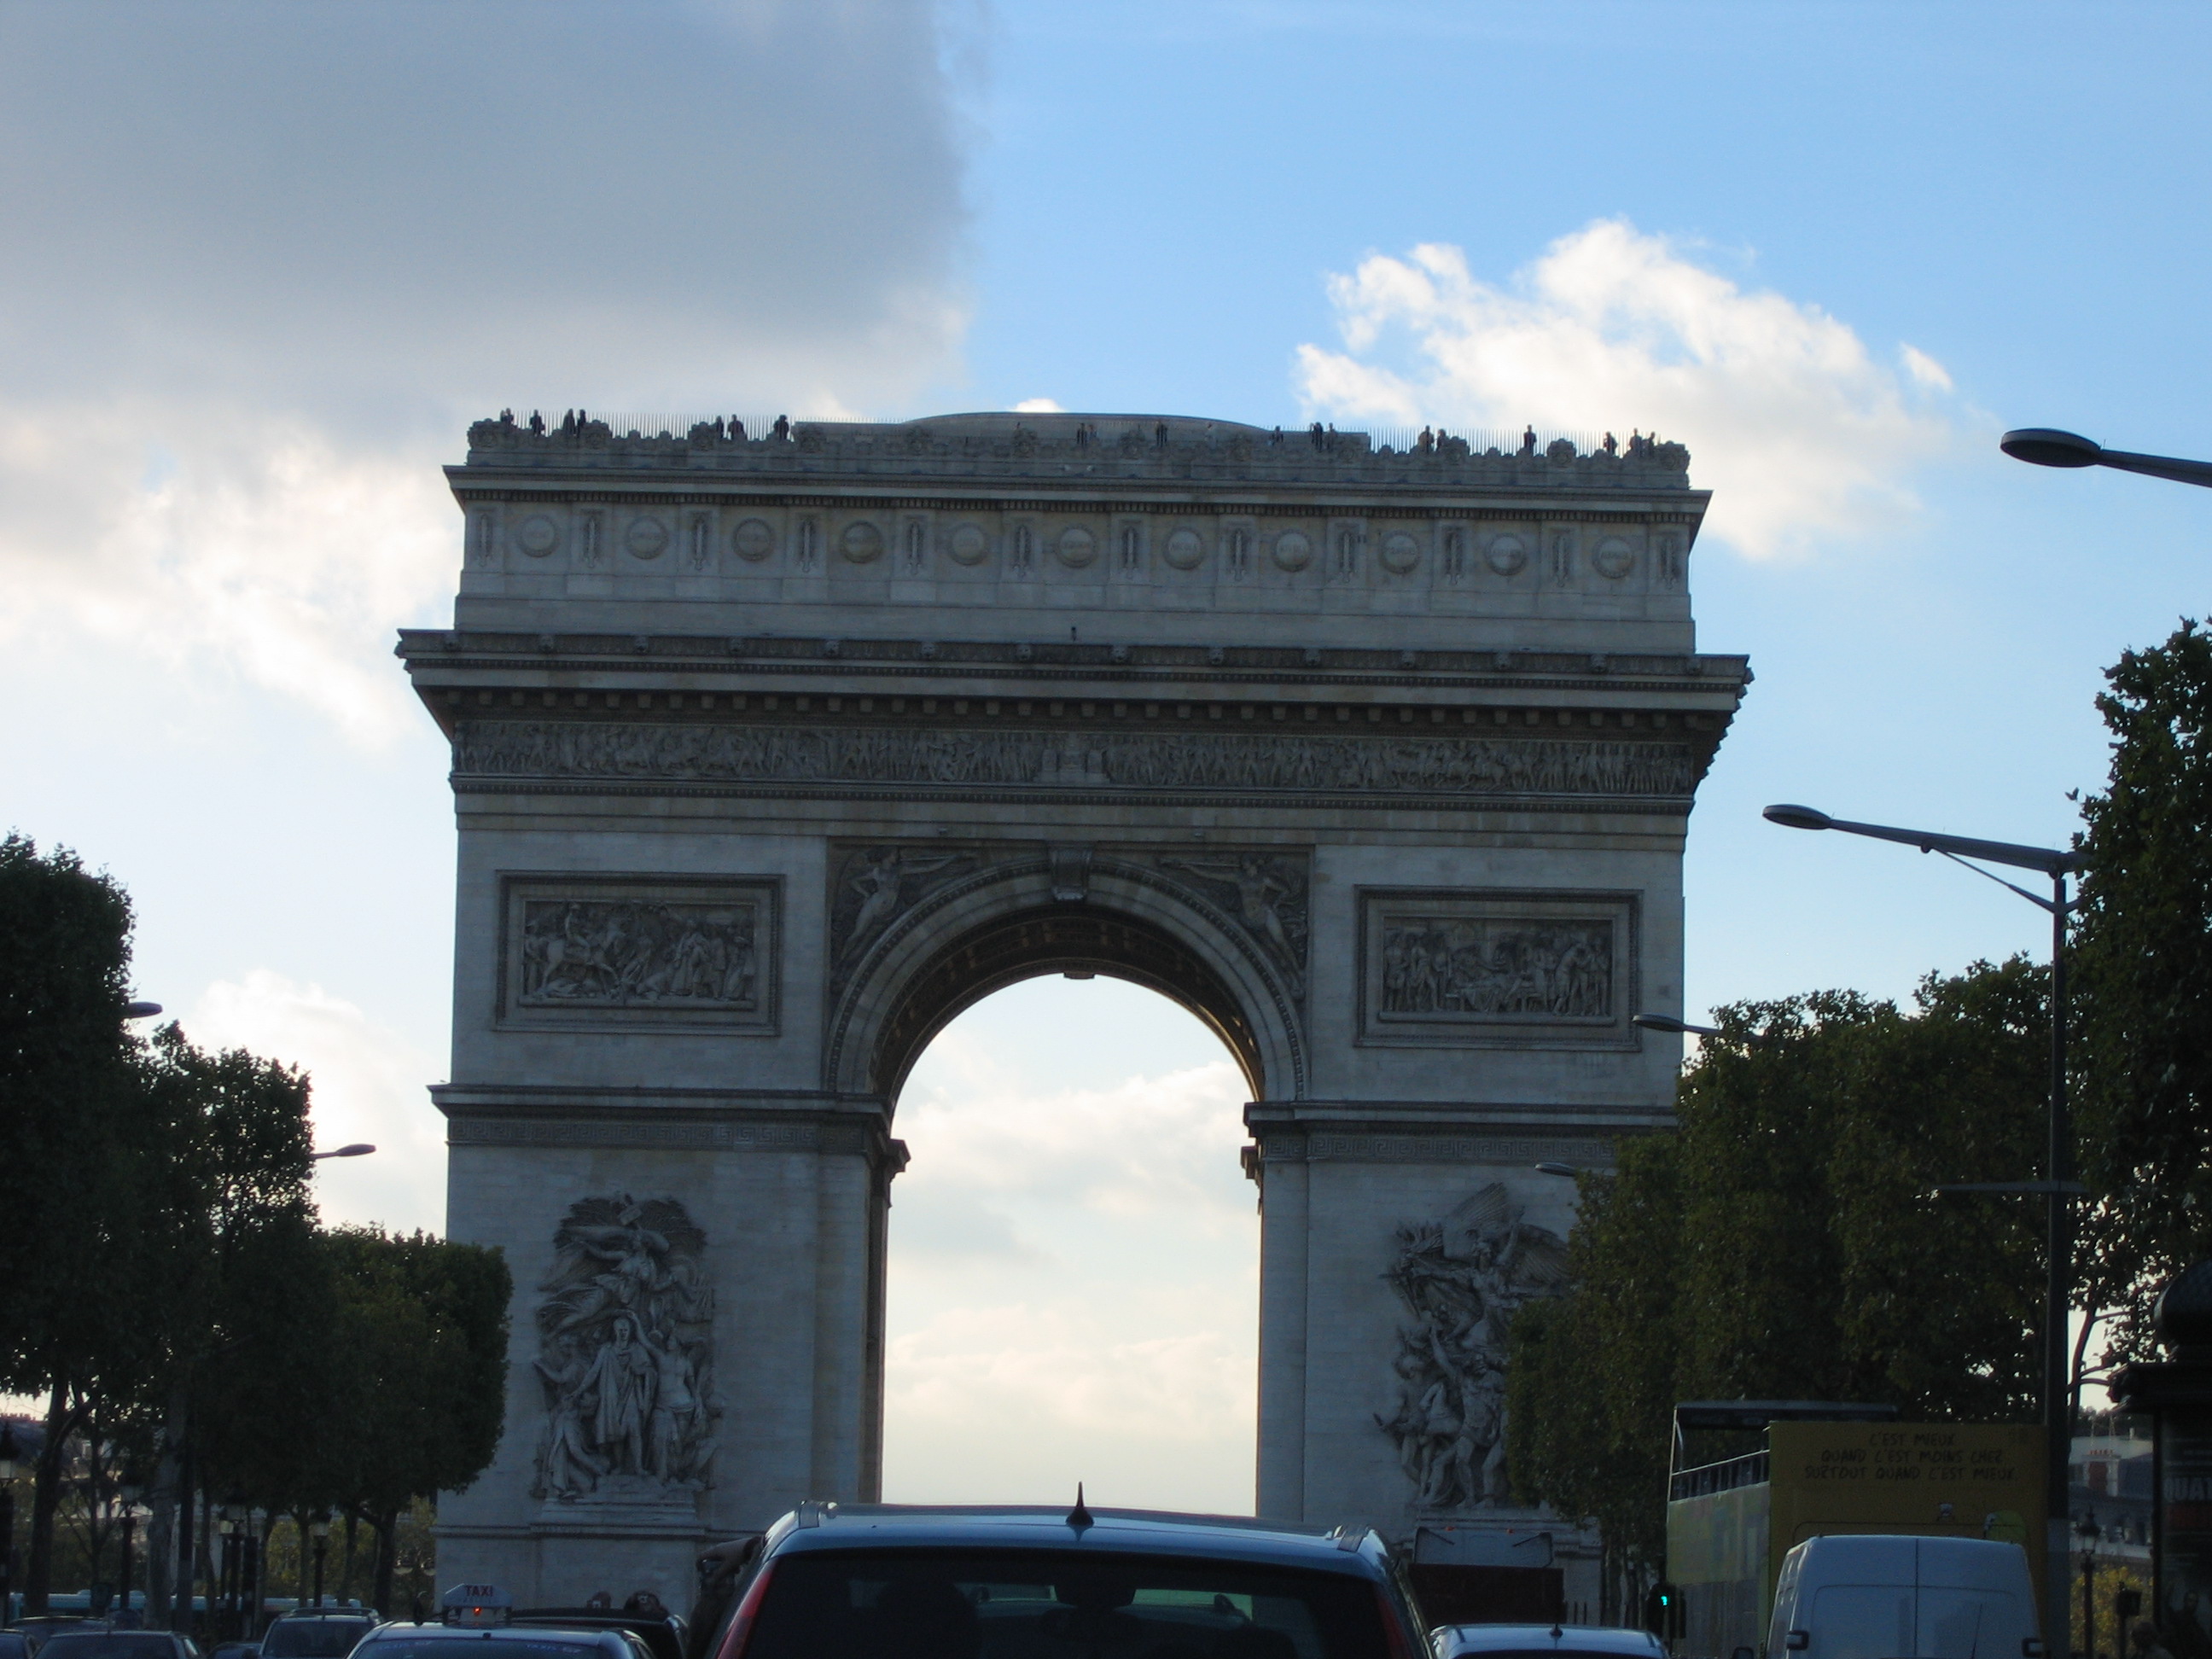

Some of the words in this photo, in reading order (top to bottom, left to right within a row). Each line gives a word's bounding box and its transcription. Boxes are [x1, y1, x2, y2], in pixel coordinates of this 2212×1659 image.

[1869, 1433, 1906, 1447] C'EST
[1912, 1433, 1956, 1446] MIEUX
[1820, 1449, 1866, 1464] QUAND
[1874, 1448, 1912, 1463] C'EST
[1918, 1449, 1964, 1463] MOINS
[1875, 1465, 1921, 1481] QUAND
[1928, 1465, 1965, 1480] C'EST
[464, 1585, 493, 1598] TAXI
